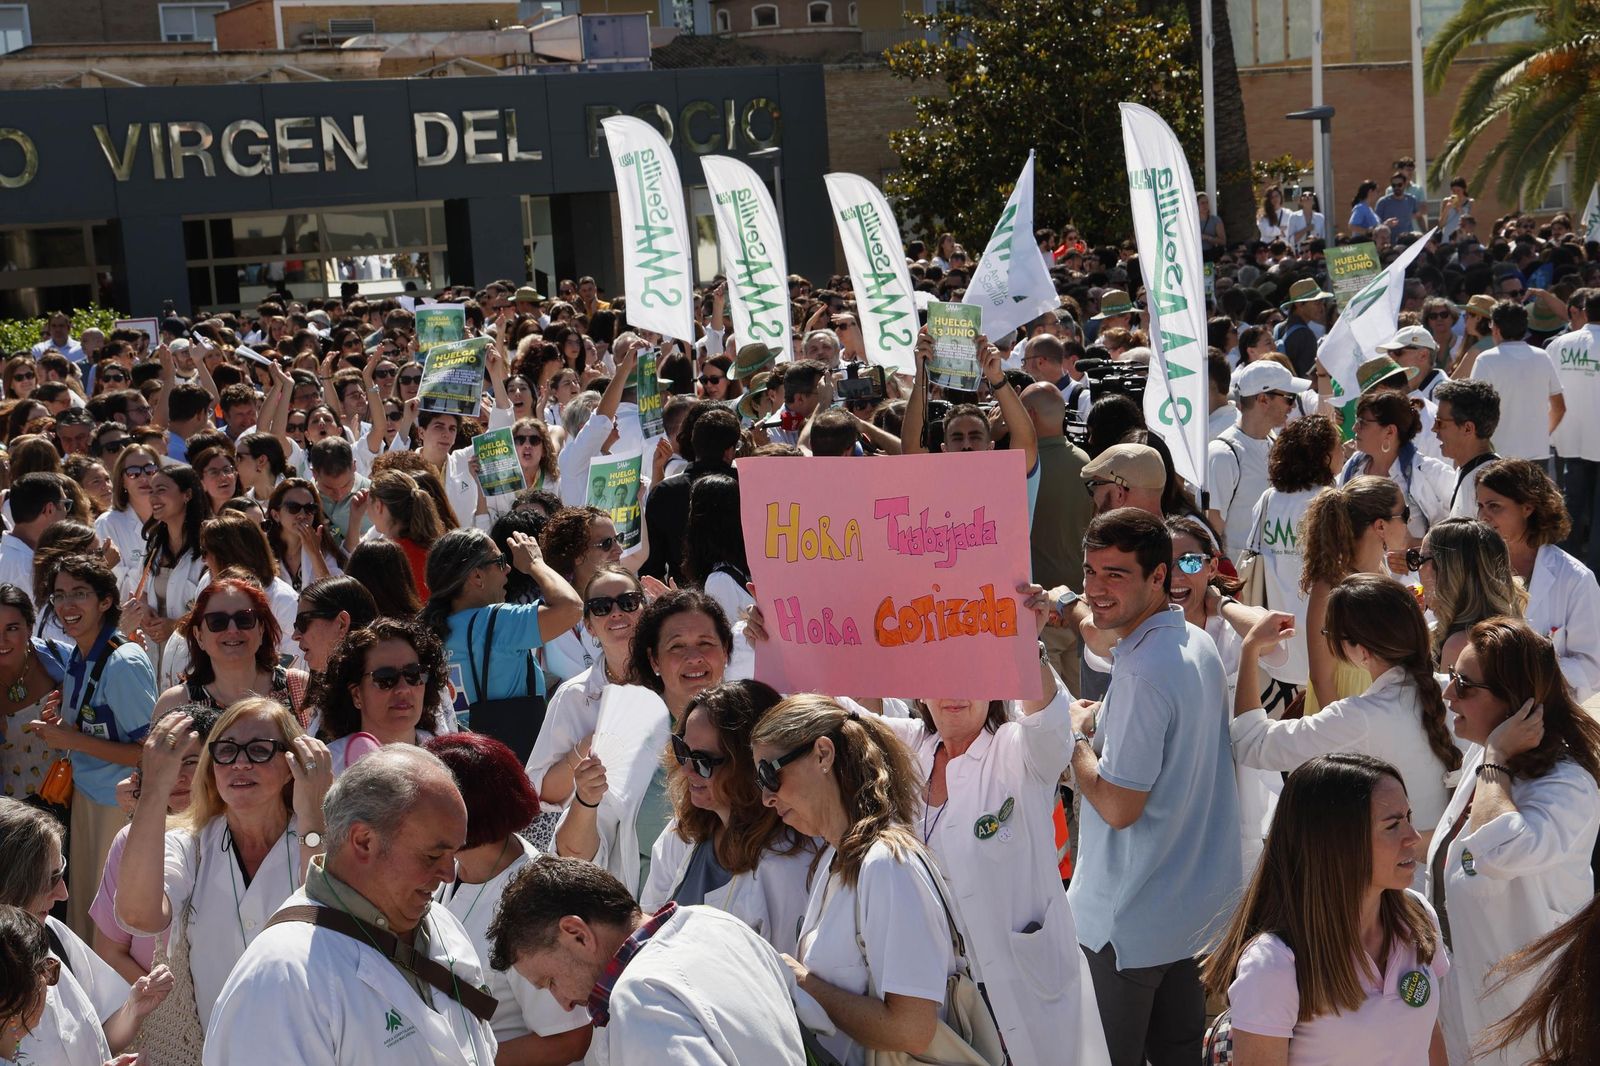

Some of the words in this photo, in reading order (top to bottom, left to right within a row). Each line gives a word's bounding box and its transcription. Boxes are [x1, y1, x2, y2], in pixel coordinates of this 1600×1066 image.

[93, 114, 369, 182] VIRGEN
[413, 108, 543, 167] DEL
[1334, 253, 1370, 266] HUELGA
[1334, 267, 1345, 275] 13
[1346, 261, 1373, 272] JUNIO
[934, 317, 974, 328] HUELGA
[933, 328, 944, 336] 13
[945, 328, 976, 337] JUNIO
[436, 349, 476, 362] HUELGA
[445, 356, 477, 368] JUNIO
[478, 439, 507, 451] HUELGA
[487, 446, 509, 457] JUNIO
[609, 468, 636, 480] HUELGA
[617, 475, 637, 486] JUNIO
[873, 496, 998, 568] Trabajada
[1405, 973, 1420, 1002] HUELGA
